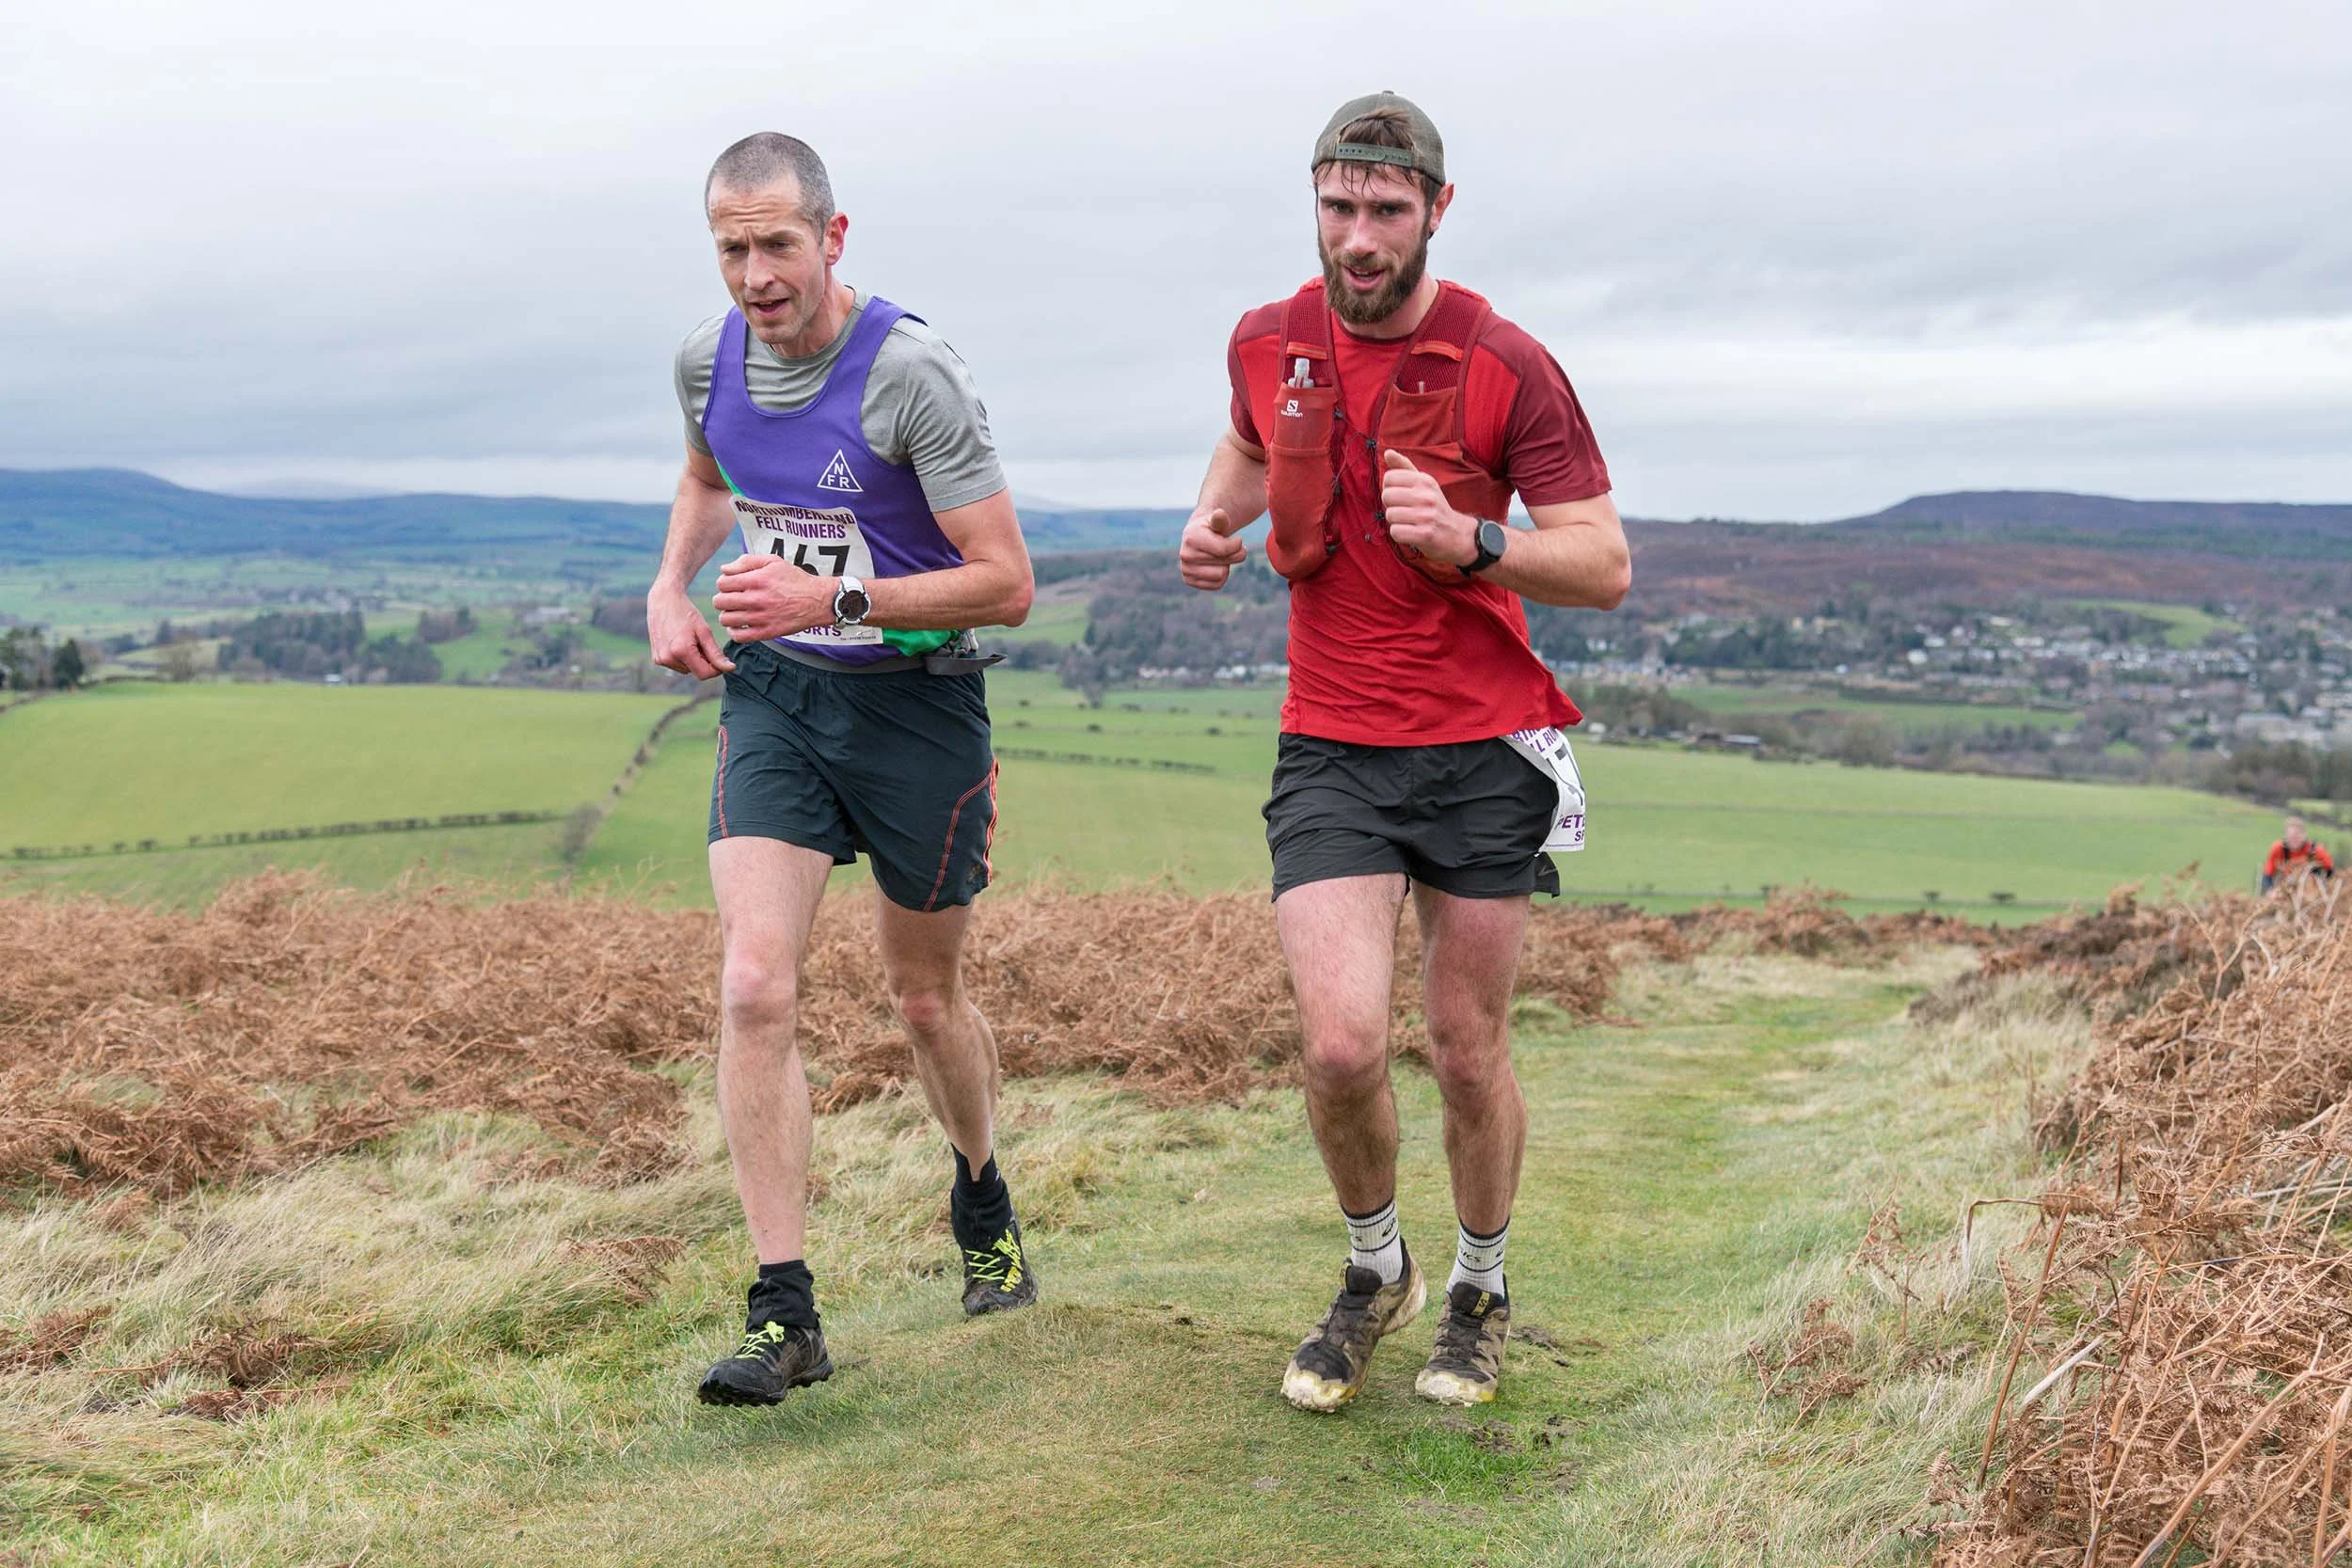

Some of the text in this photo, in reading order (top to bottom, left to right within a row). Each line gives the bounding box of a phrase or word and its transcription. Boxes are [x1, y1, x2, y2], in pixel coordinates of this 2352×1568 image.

[834, 462, 844, 476] N
[756, 515, 847, 539] FELL RUNNERS
